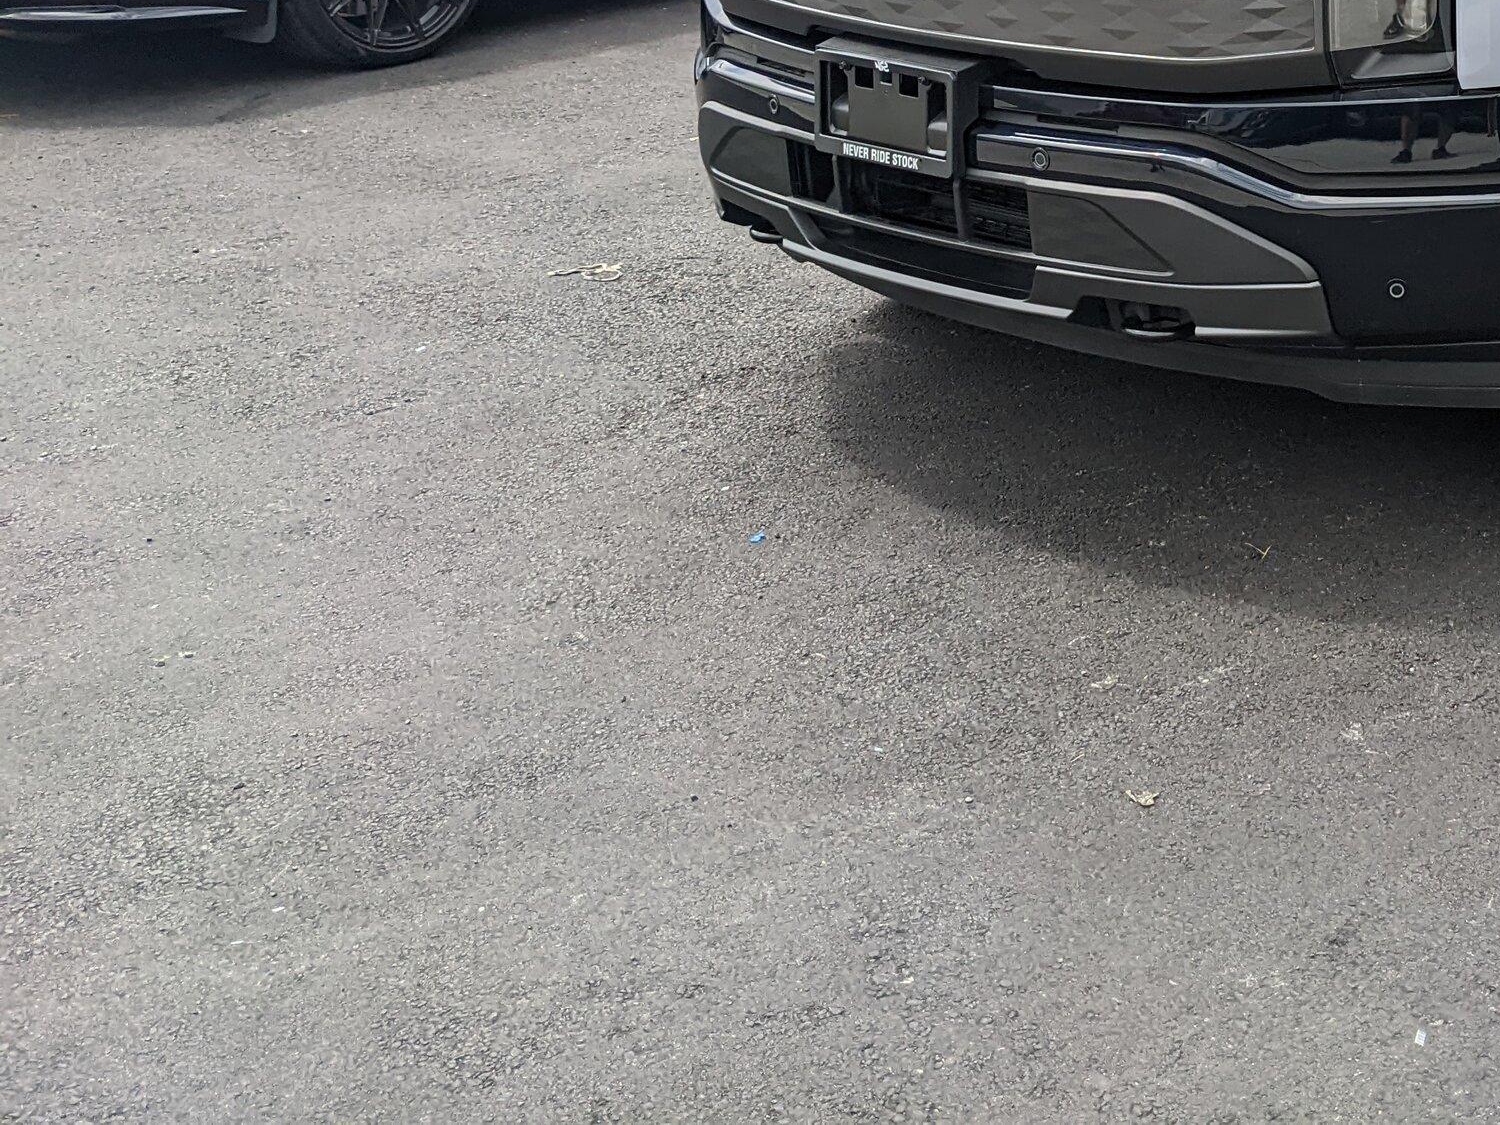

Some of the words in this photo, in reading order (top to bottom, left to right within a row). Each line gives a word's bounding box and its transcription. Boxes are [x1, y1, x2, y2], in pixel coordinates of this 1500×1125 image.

[843, 142, 869, 160] NEVER
[871, 149, 891, 164] RIDE
[892, 153, 919, 171] STOCK
